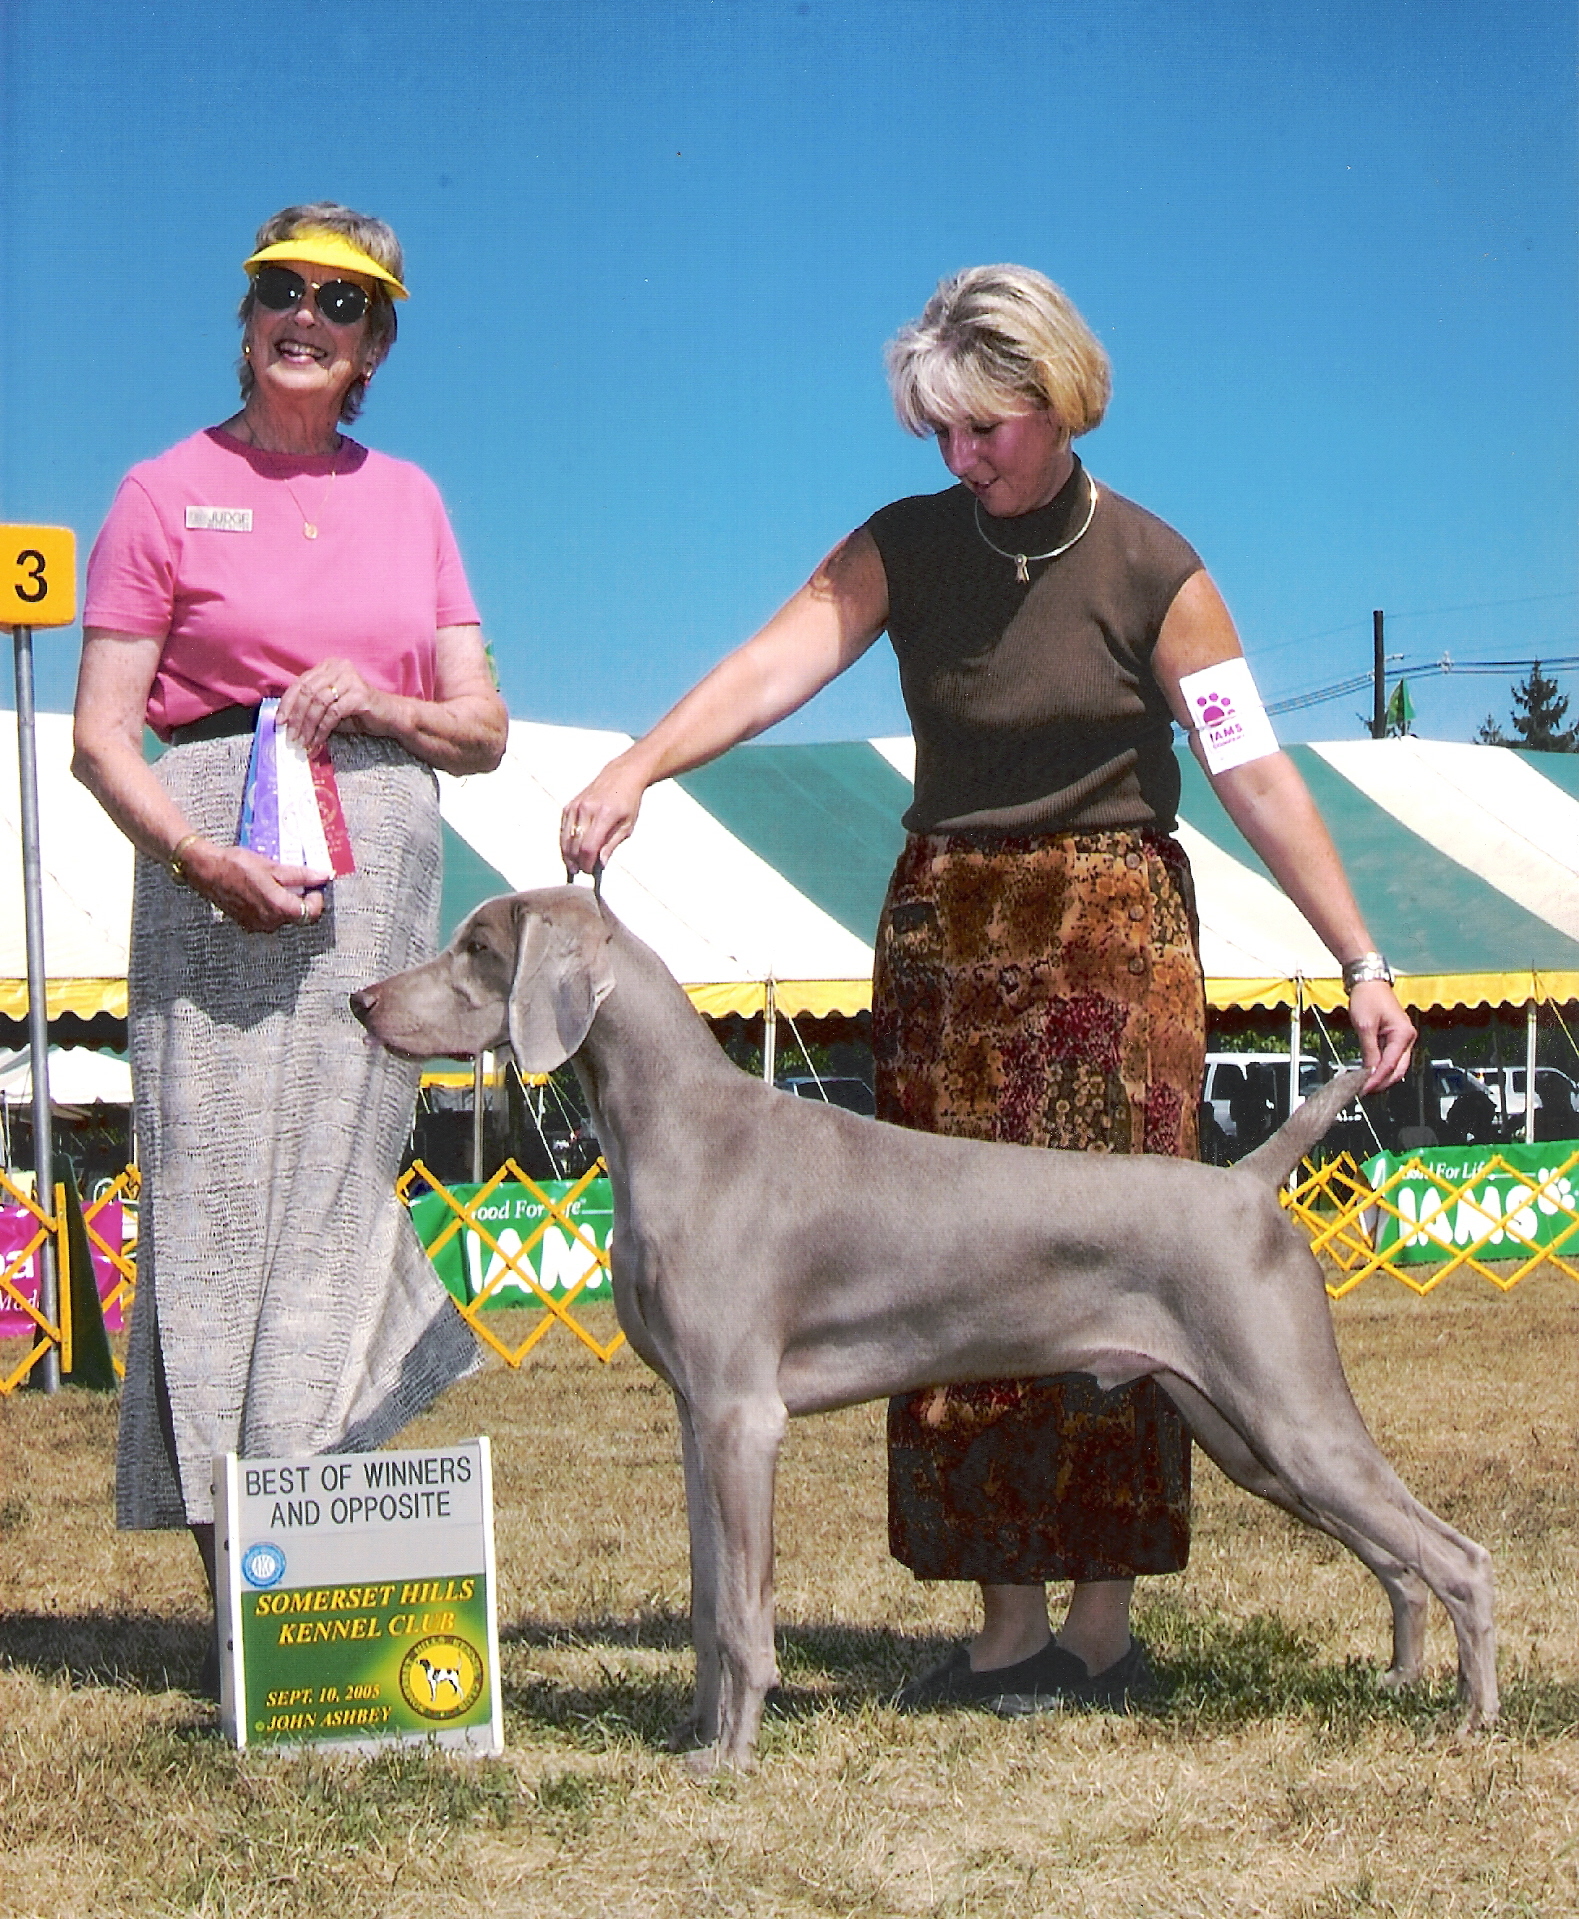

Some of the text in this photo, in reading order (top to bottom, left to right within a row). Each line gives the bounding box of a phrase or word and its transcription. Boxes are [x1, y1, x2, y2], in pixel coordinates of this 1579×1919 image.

[14, 549, 48, 603] 3
[464, 1199, 510, 1221] ood
[515, 1199, 545, 1219] For
[1398, 1186, 1538, 1247] IAMS
[466, 1222, 613, 1296] IAM
[246, 1456, 472, 1496] BEST OF WINNERS
[270, 1491, 451, 1528] AND OPPOSITE
[255, 1579, 475, 1616] SOMERSET HILLS
[278, 1611, 456, 1645] KENNEL CLUB
[266, 1688, 313, 1707] SEPT.
[266, 1706, 392, 1732] JOHN ASHBEY
